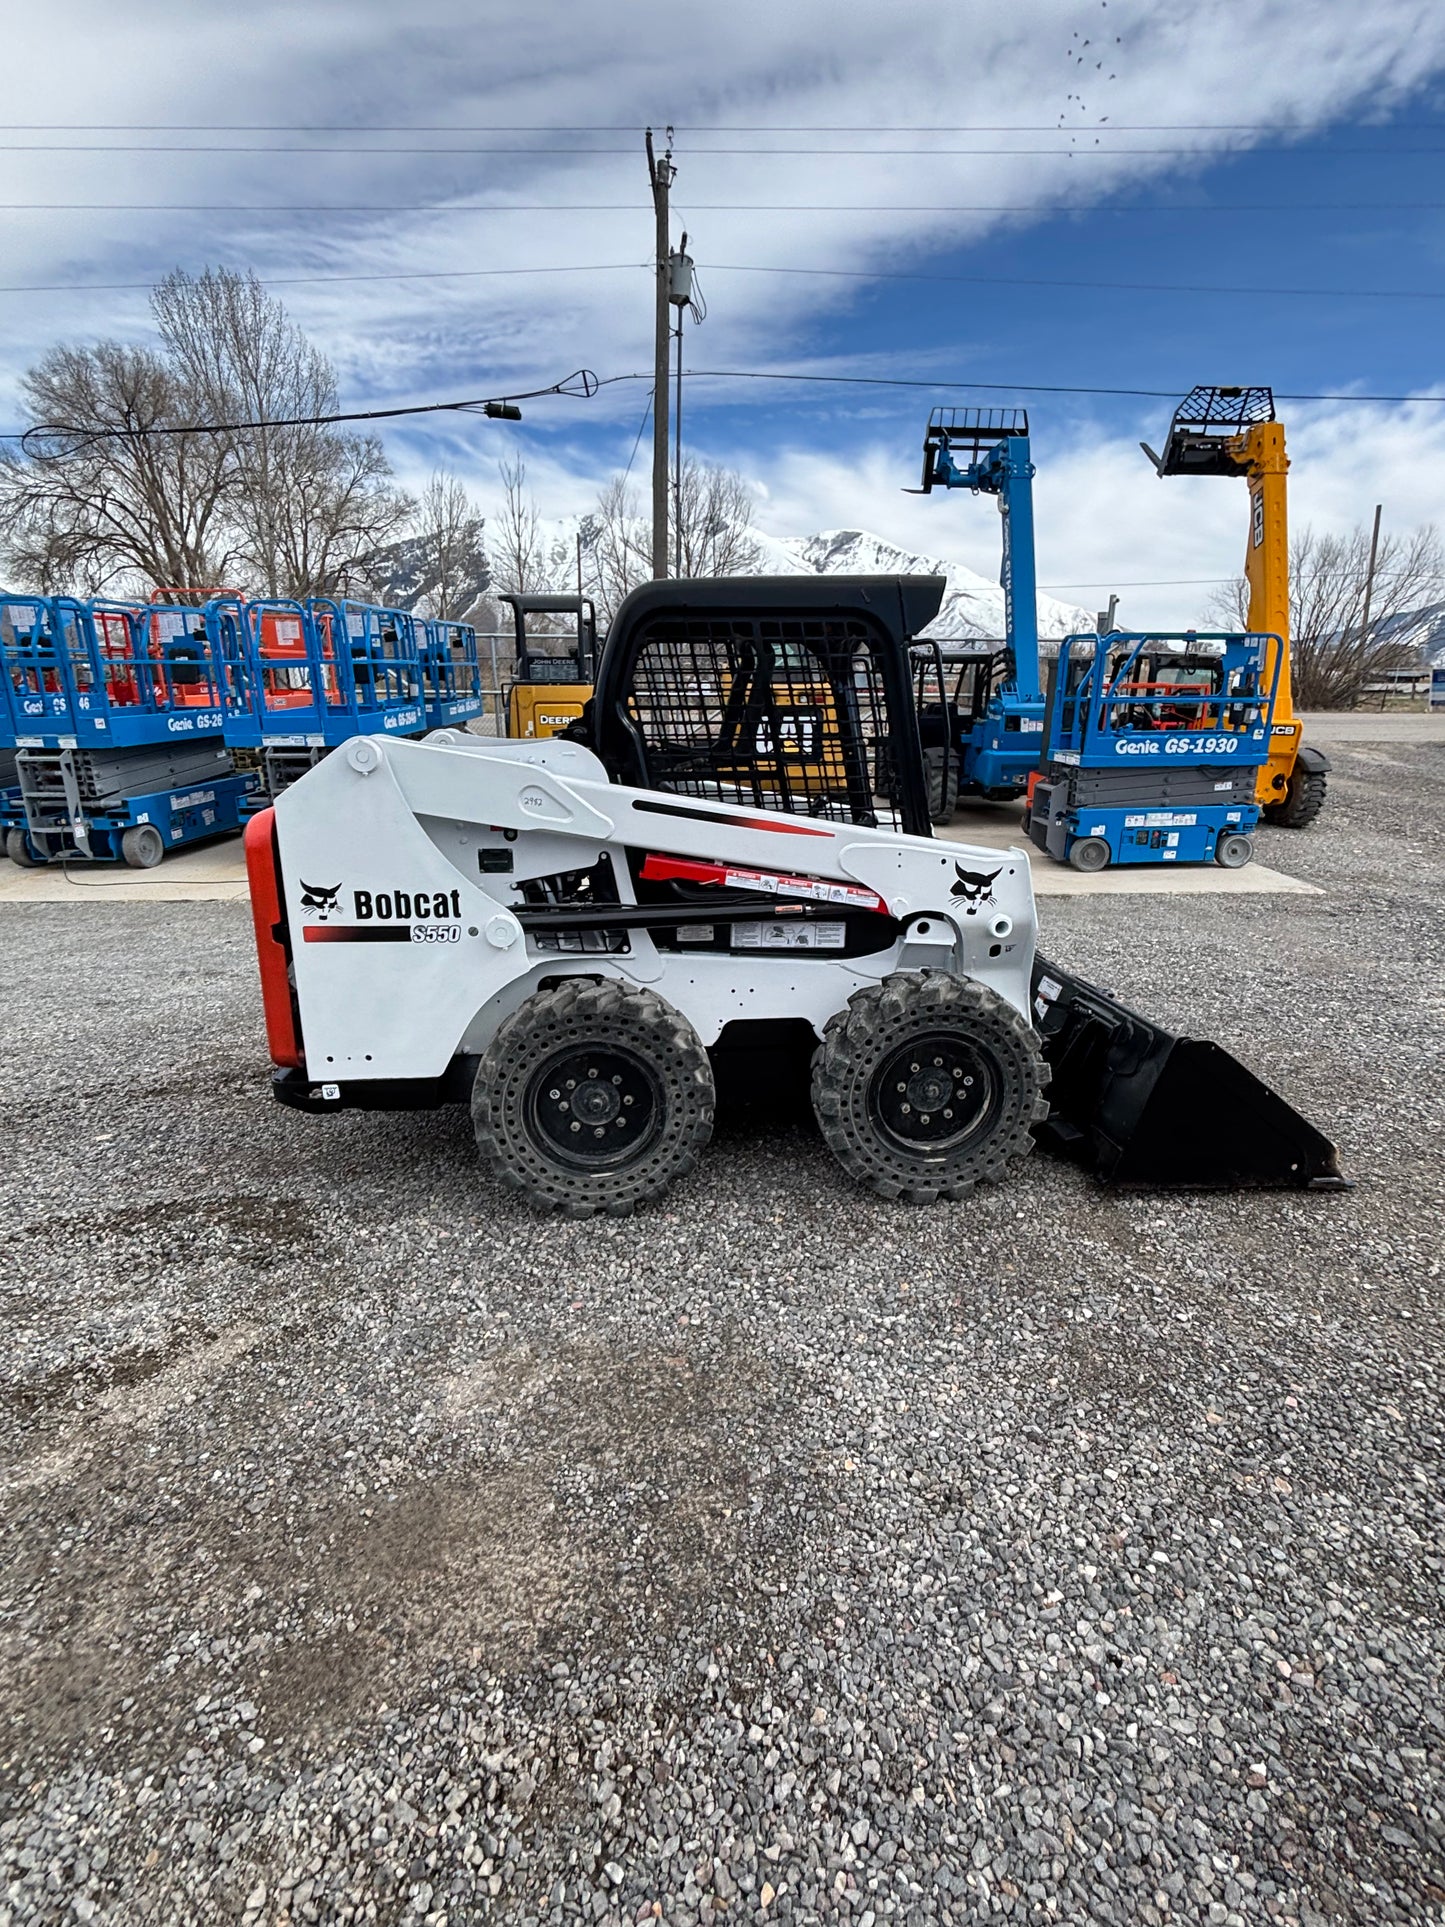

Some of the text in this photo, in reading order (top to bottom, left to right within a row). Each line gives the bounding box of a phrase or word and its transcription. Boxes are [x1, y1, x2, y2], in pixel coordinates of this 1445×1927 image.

[1254, 494, 1263, 547] JCB
[167, 717, 194, 732] Genie
[1270, 726, 1295, 735] JCB
[1115, 738, 1238, 754] Genie GS-1930
[353, 889, 461, 919] Bobcat
[412, 925, 461, 943] S550
